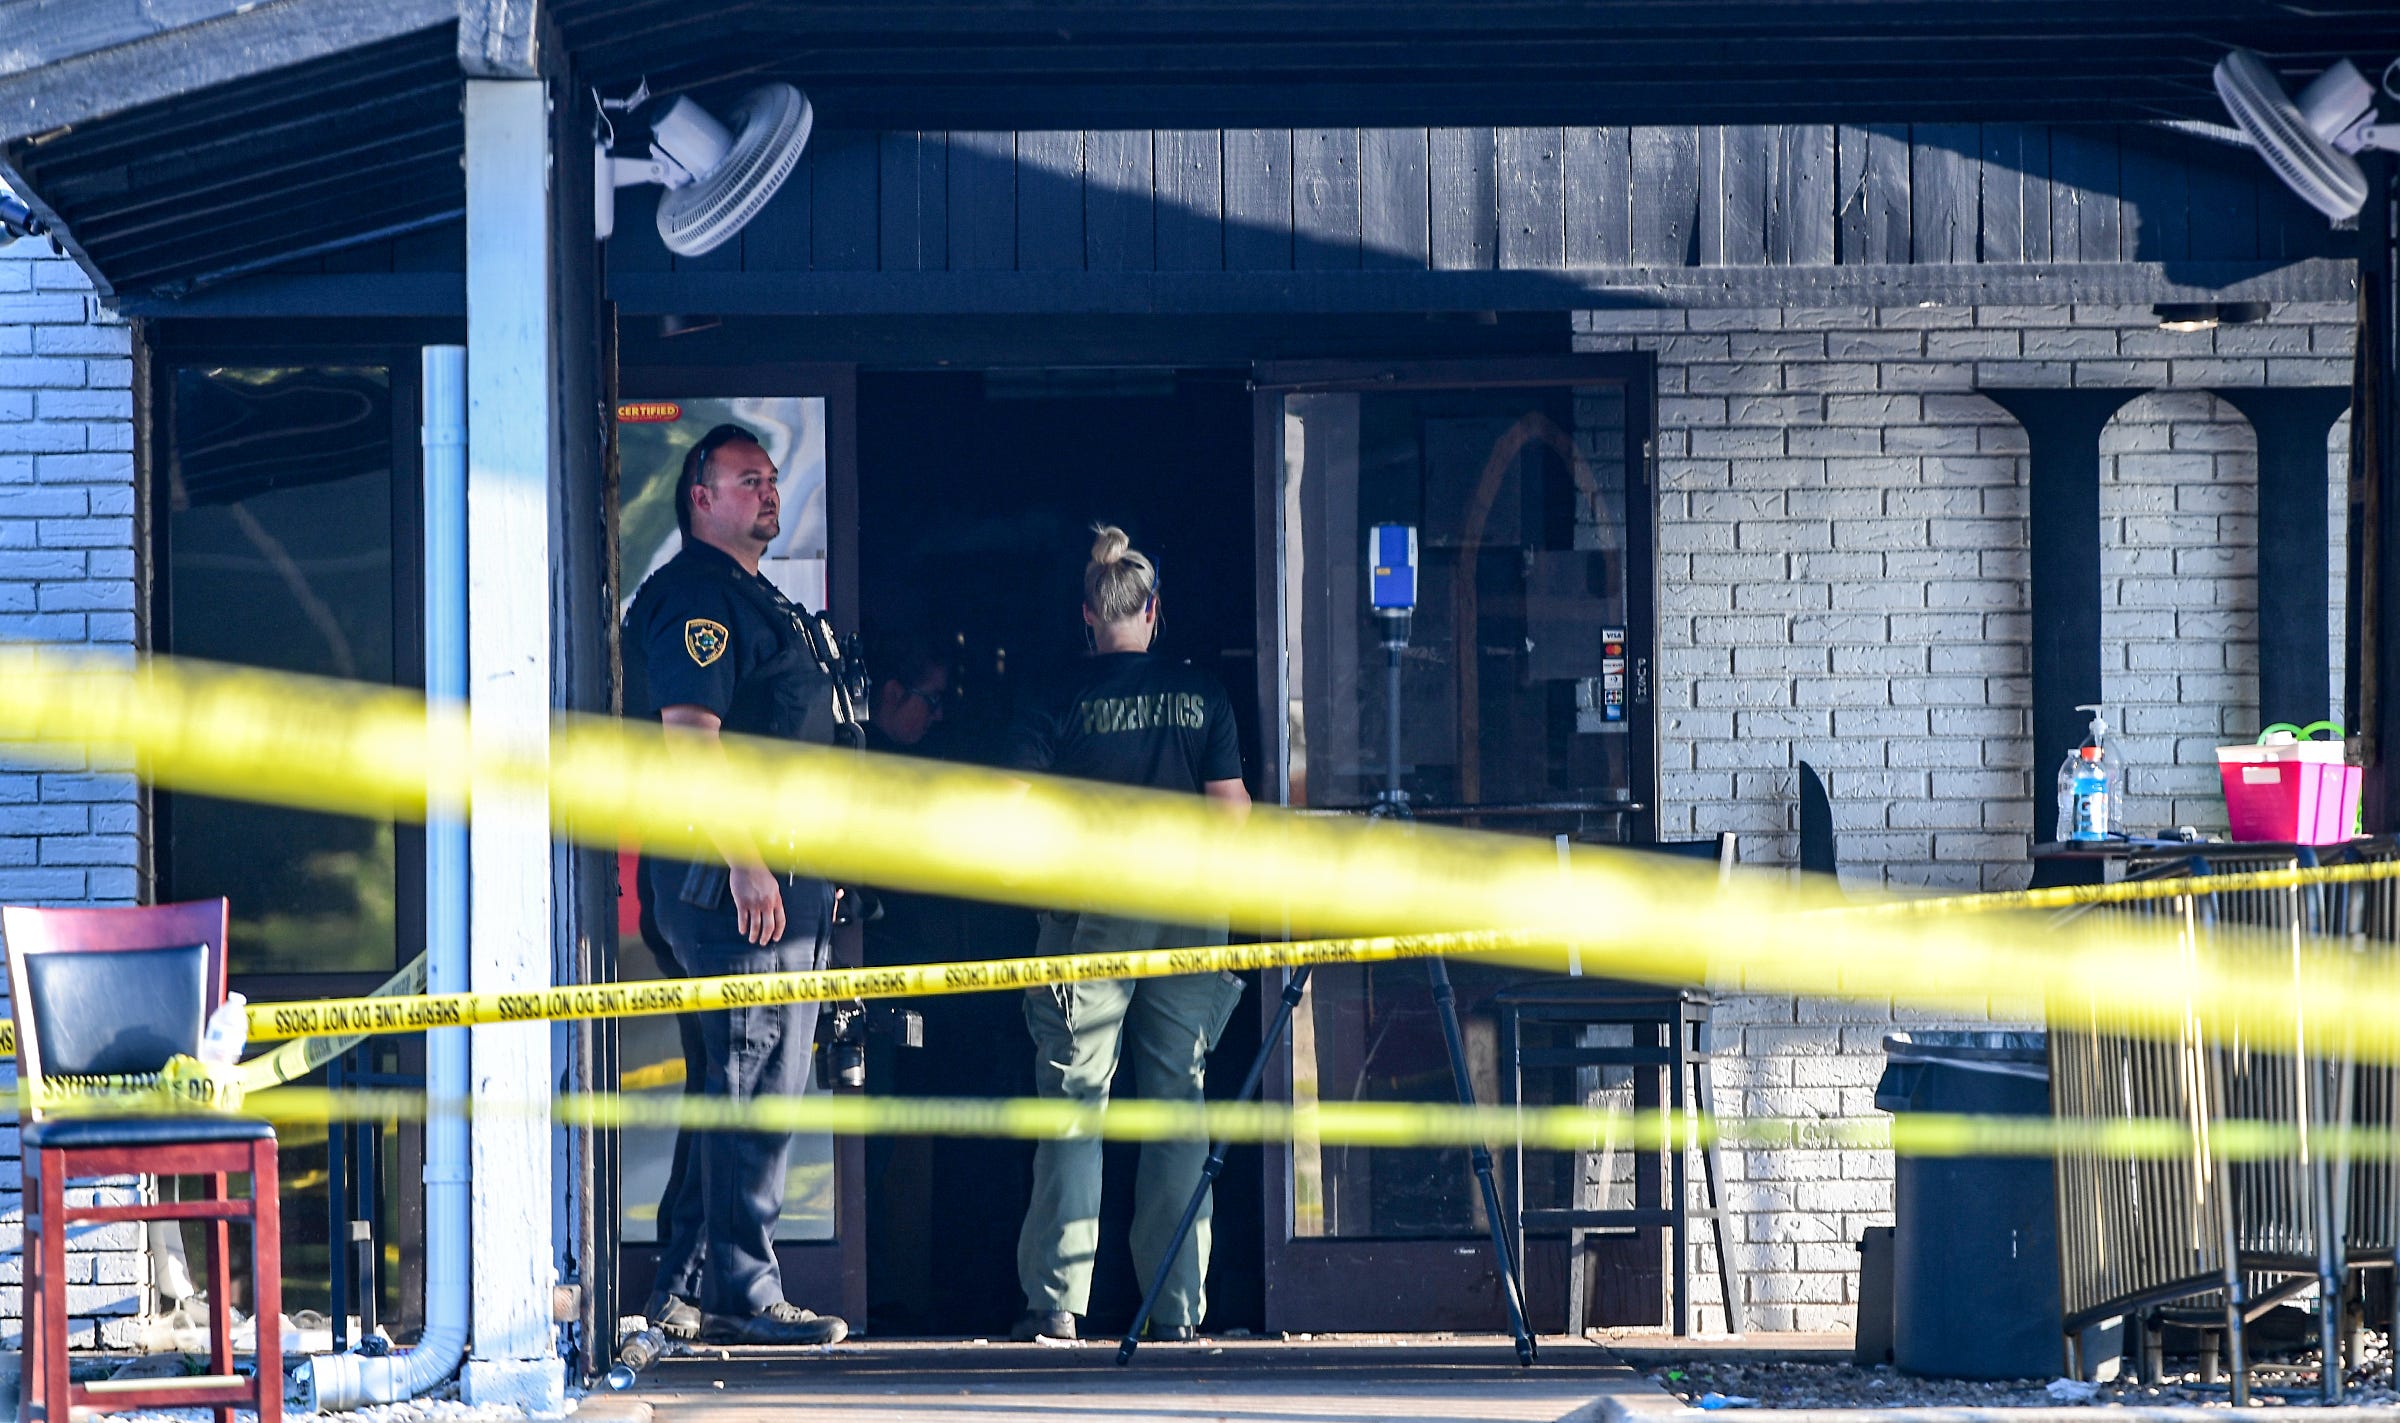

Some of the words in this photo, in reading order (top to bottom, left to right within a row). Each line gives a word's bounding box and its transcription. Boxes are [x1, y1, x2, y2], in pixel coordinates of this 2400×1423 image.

[617, 405, 676, 416] CERTIFIED
[1636, 657, 1647, 696] PUSH
[1080, 691, 1204, 735] FORENSICS
[1023, 962, 1041, 983] DO
[1046, 960, 1075, 981] LINE
[1078, 957, 1131, 979] SHERIFF
[1169, 951, 1210, 974] CROSS
[854, 972, 907, 995] SHERIFF
[945, 966, 989, 989] CROSS
[993, 964, 1019, 986] NOT
[631, 986, 683, 1011] SHERIFF
[721, 981, 765, 1004] CROSS
[770, 979, 795, 1002] NOT
[800, 978, 816, 998] DO
[821, 976, 851, 998] LINE
[408, 999, 460, 1026] SHERIFF
[498, 995, 542, 1020] CROSS
[546, 992, 571, 1016] NOT
[575, 992, 594, 1014] DO
[598, 990, 628, 1013] LINE
[275, 1009, 317, 1034] CROSS
[323, 1006, 350, 1031] NOT
[353, 1005, 370, 1029] DO
[376, 1003, 404, 1027] LINE
